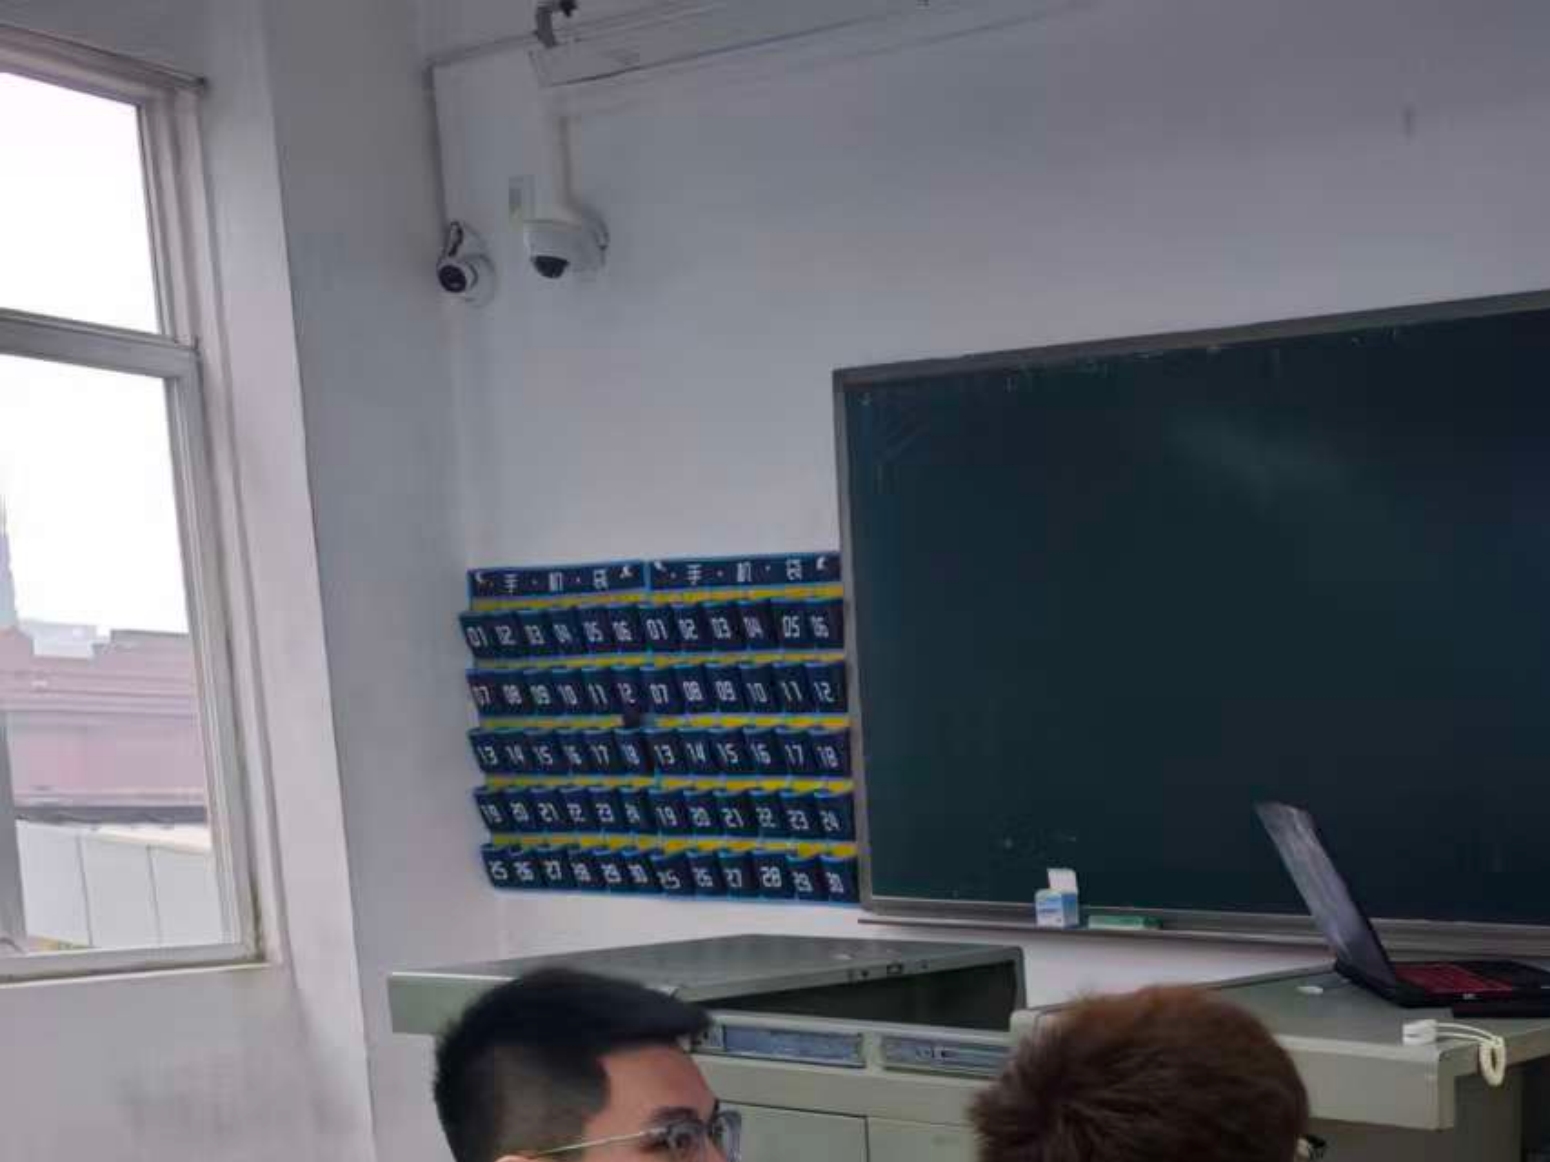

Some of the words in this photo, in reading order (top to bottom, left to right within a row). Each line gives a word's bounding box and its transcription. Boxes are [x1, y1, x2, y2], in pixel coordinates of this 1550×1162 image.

[647, 619, 668, 640] 01
[679, 619, 698, 640] 02
[711, 618, 731, 639] 03
[744, 617, 763, 638] 04
[783, 616, 800, 637] 05
[650, 684, 669, 703] 07
[683, 681, 702, 701] 08
[716, 681, 735, 701] 09
[747, 683, 768, 702] 10
[782, 682, 802, 701] 11
[814, 683, 834, 702] 12
[654, 745, 675, 765] 13
[686, 743, 706, 763] 14
[717, 744, 738, 763] 15
[751, 744, 771, 764] 16
[785, 745, 803, 765] 17
[656, 807, 677, 826] 19
[721, 808, 743, 827] 21
[787, 810, 808, 829] 23
[657, 870, 680, 888] 25
[724, 869, 742, 887] 27
[760, 866, 781, 887] 28
